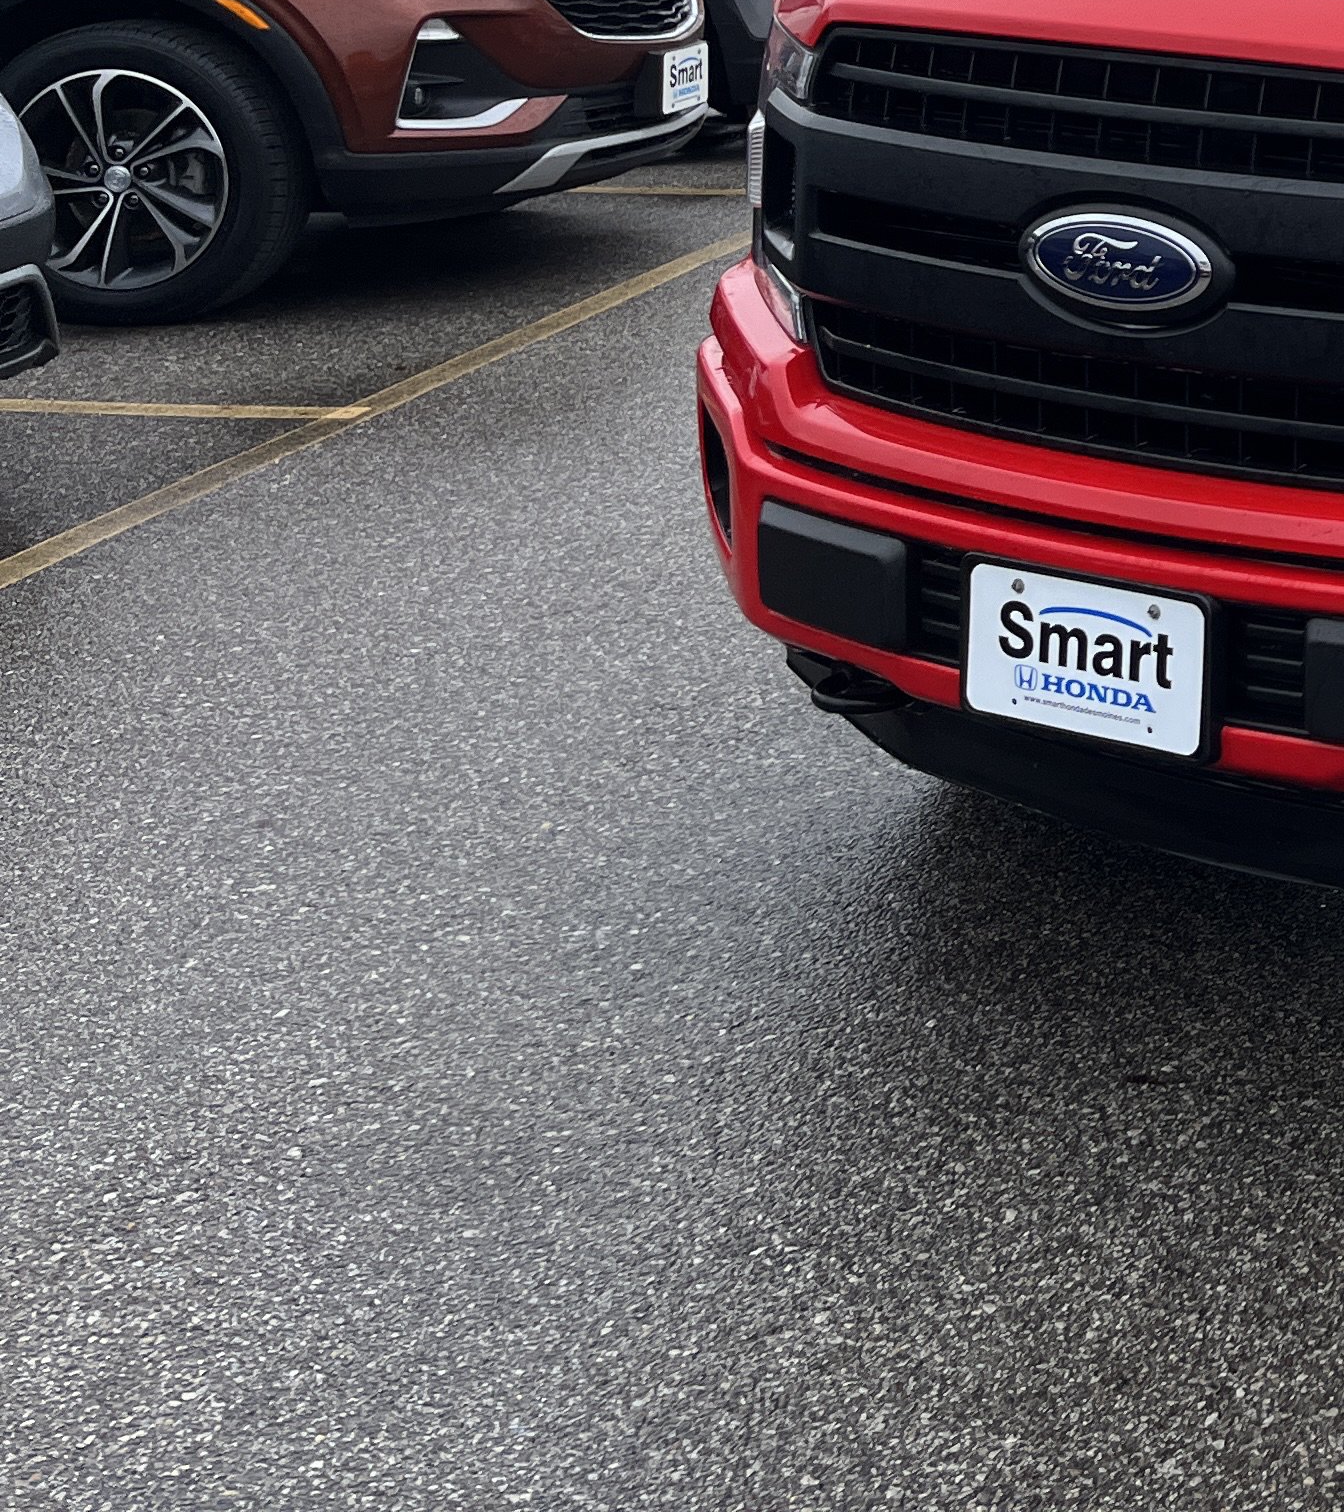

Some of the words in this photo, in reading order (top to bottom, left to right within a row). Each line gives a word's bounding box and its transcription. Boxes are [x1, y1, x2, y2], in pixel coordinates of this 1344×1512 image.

[669, 58, 703, 88] Smart
[1062, 232, 1163, 290] Ford
[998, 600, 1174, 690] Smart
[1041, 672, 1157, 713] HONDA
